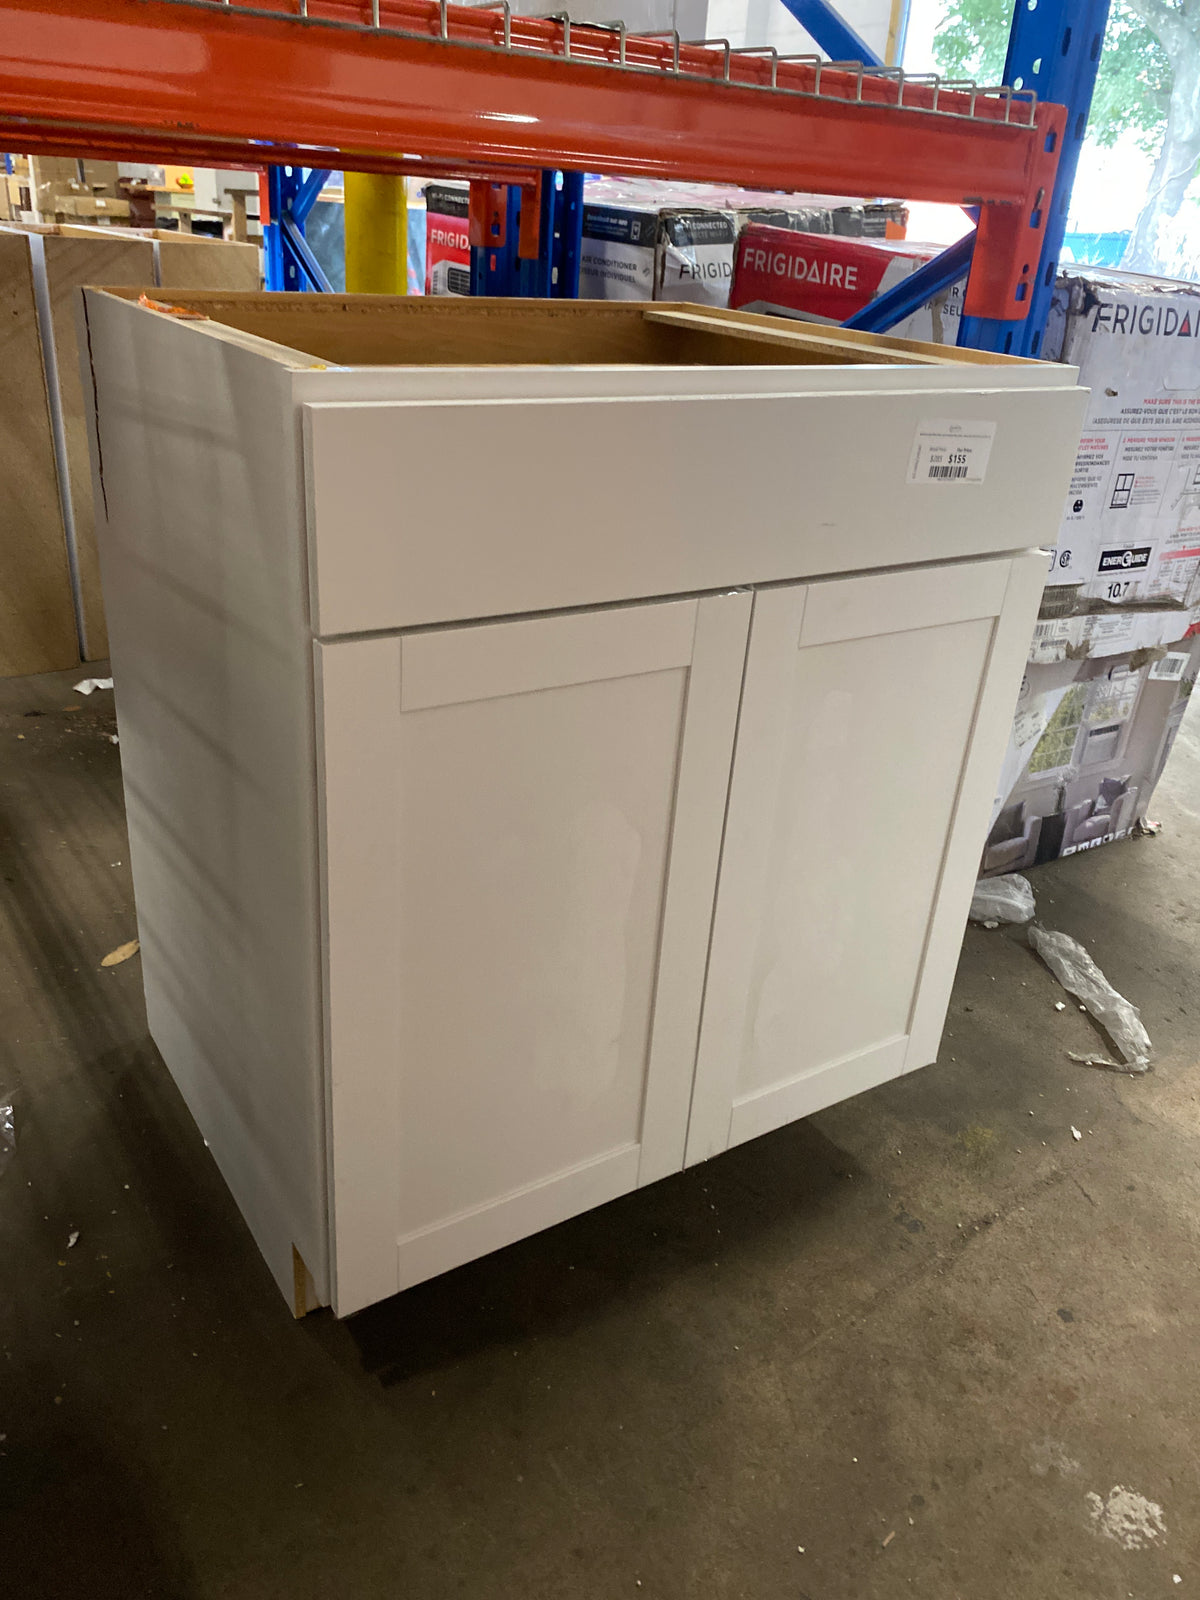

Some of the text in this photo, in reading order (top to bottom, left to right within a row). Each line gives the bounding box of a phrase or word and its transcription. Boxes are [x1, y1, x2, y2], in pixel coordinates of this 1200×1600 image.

[431, 229, 470, 250] FRIGID
[593, 258, 637, 271] CONDITIONER
[743, 248, 859, 291] FRIGIDAIRE
[948, 453, 967, 464] $155
[1102, 551, 1148, 568] ENERGUIDE
[1108, 582, 1130, 599] 10.7
